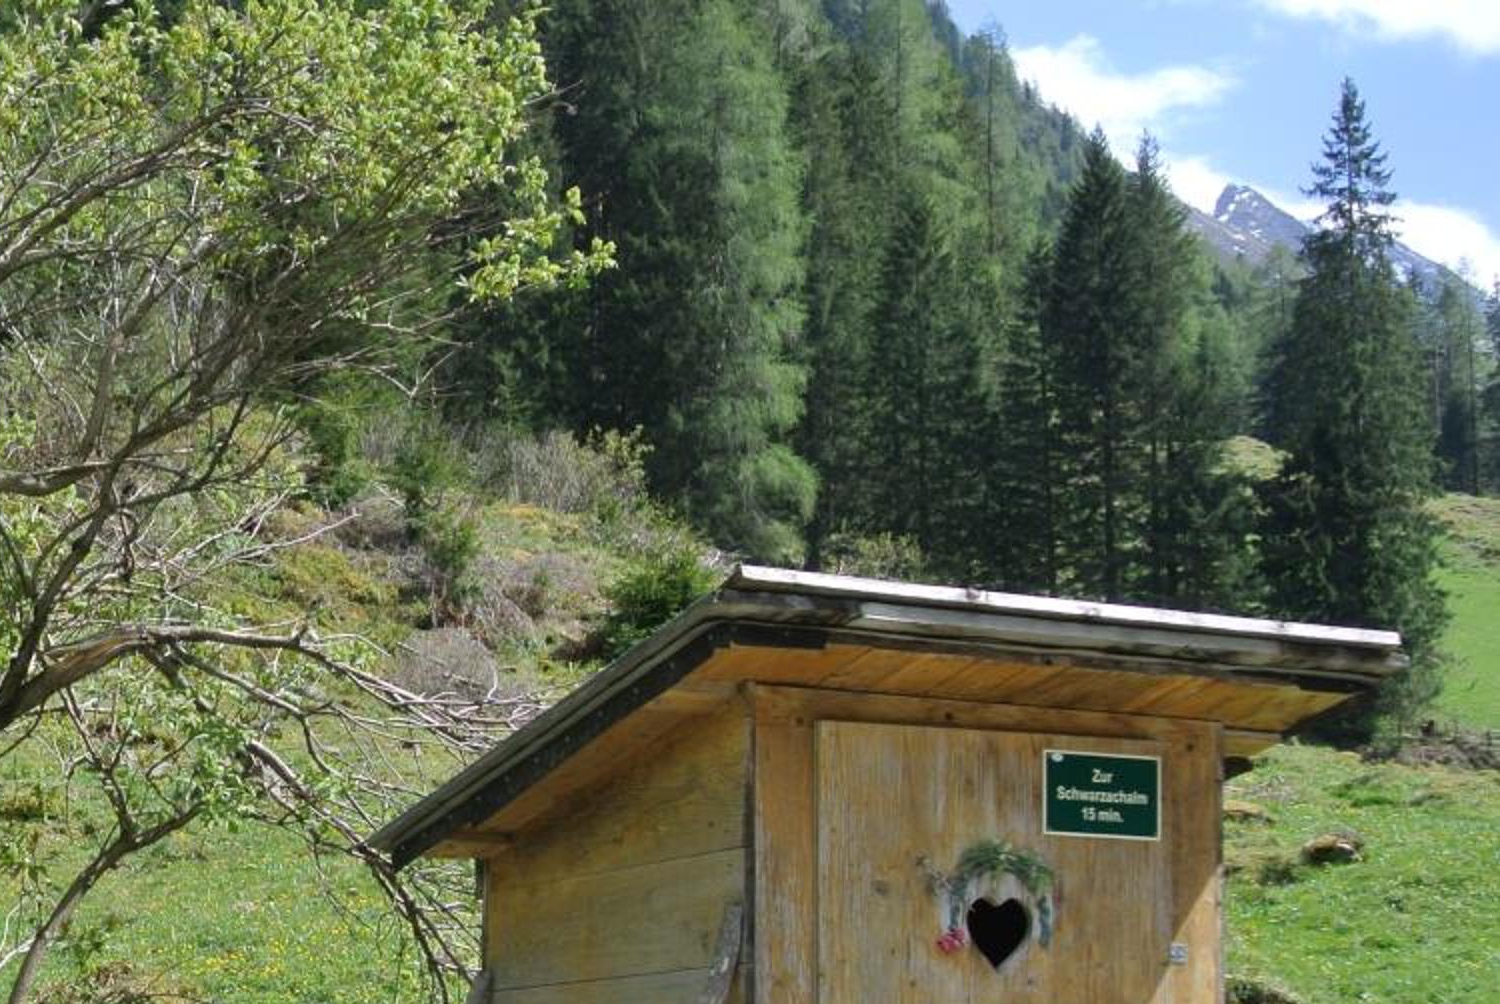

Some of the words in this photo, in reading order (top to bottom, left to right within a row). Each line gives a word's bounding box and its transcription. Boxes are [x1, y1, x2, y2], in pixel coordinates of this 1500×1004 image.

[1091, 768, 1114, 783] Zur
[1057, 785, 1148, 805] Schwarzachalm
[1081, 807, 1096, 821] 15
[1097, 808, 1125, 823] min.
